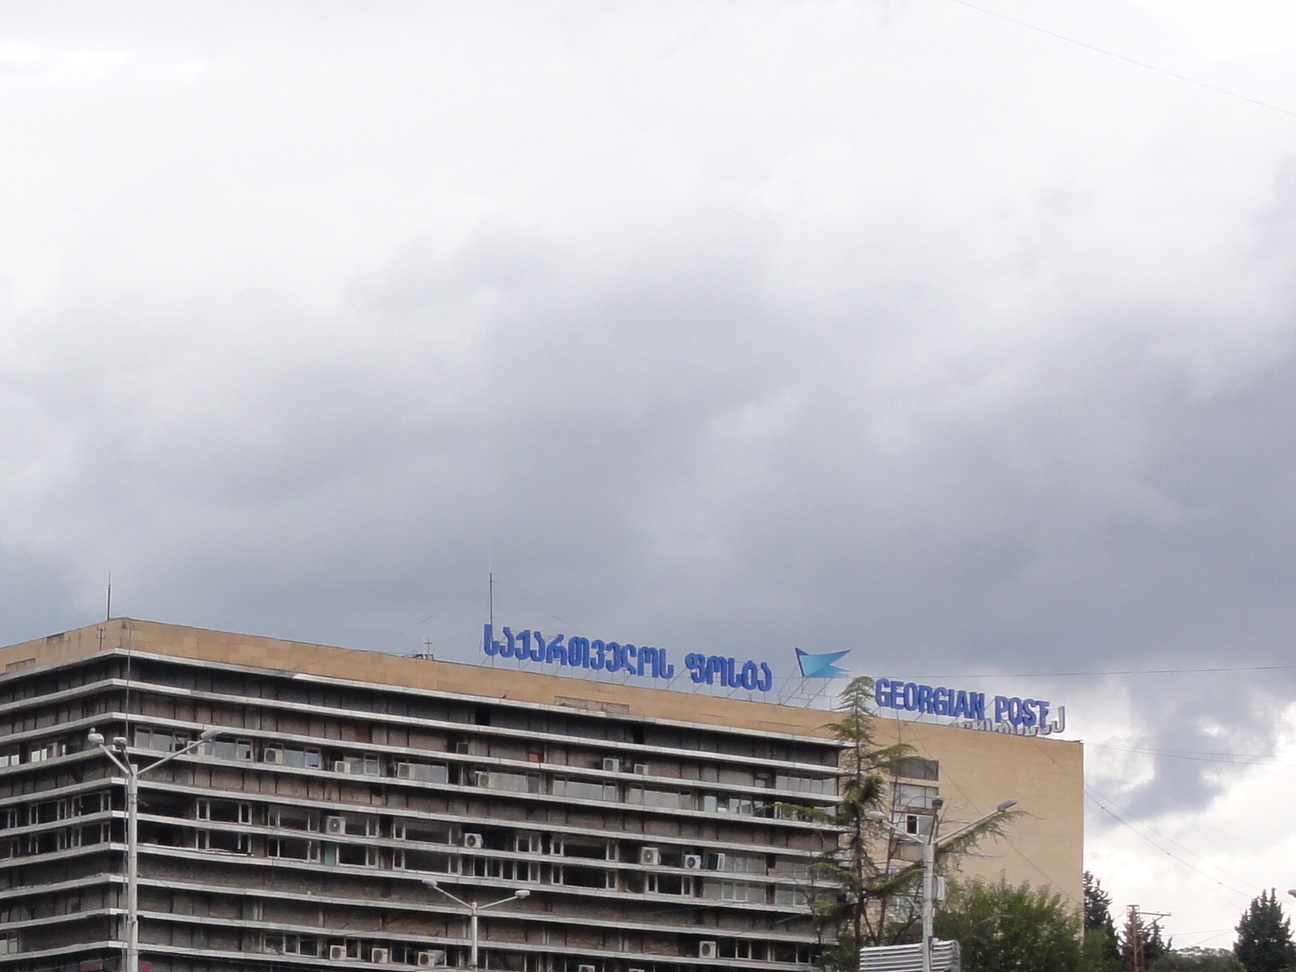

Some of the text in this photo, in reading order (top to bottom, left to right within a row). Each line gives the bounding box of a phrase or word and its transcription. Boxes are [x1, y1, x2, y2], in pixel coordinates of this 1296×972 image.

[684, 652, 772, 692] ფოსტა
[875, 678, 985, 720] GEORGIAN
[994, 695, 1050, 729] POST
